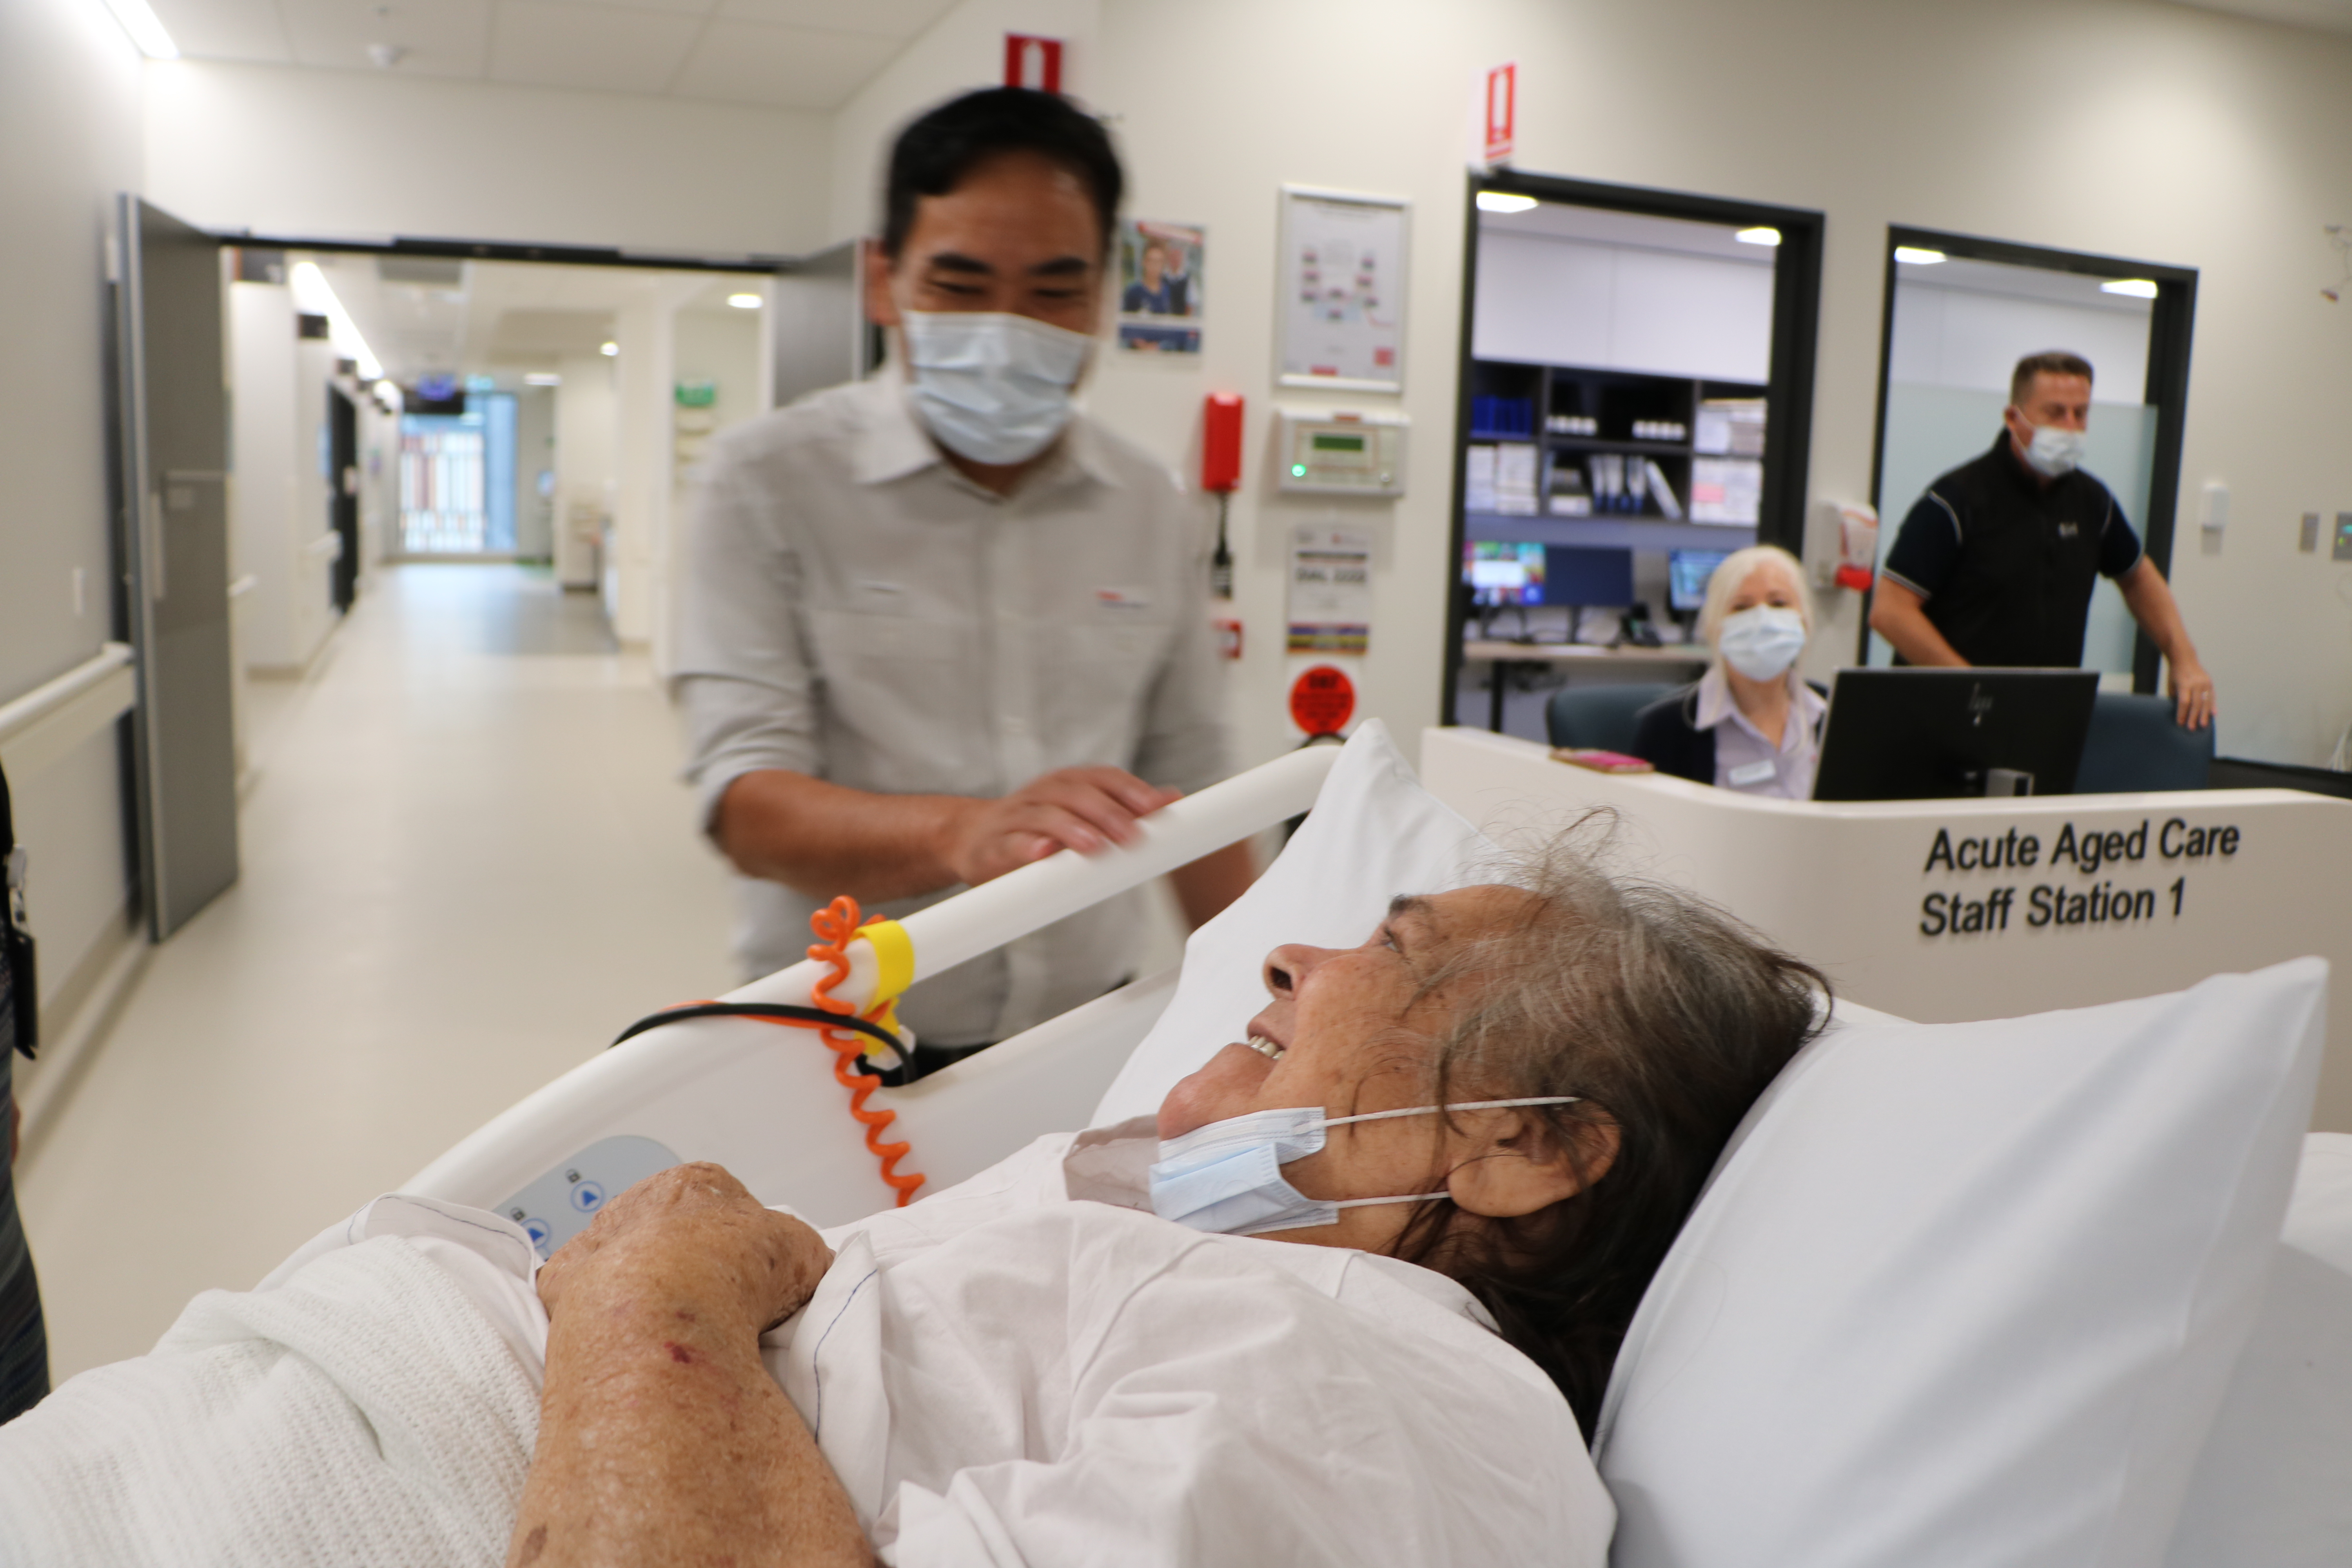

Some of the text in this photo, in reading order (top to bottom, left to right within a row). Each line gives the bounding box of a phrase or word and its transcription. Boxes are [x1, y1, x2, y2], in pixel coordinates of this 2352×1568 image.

[1924, 817, 2240, 873] Acute Aged Care
[1920, 876, 2186, 936] Staff Station 1
